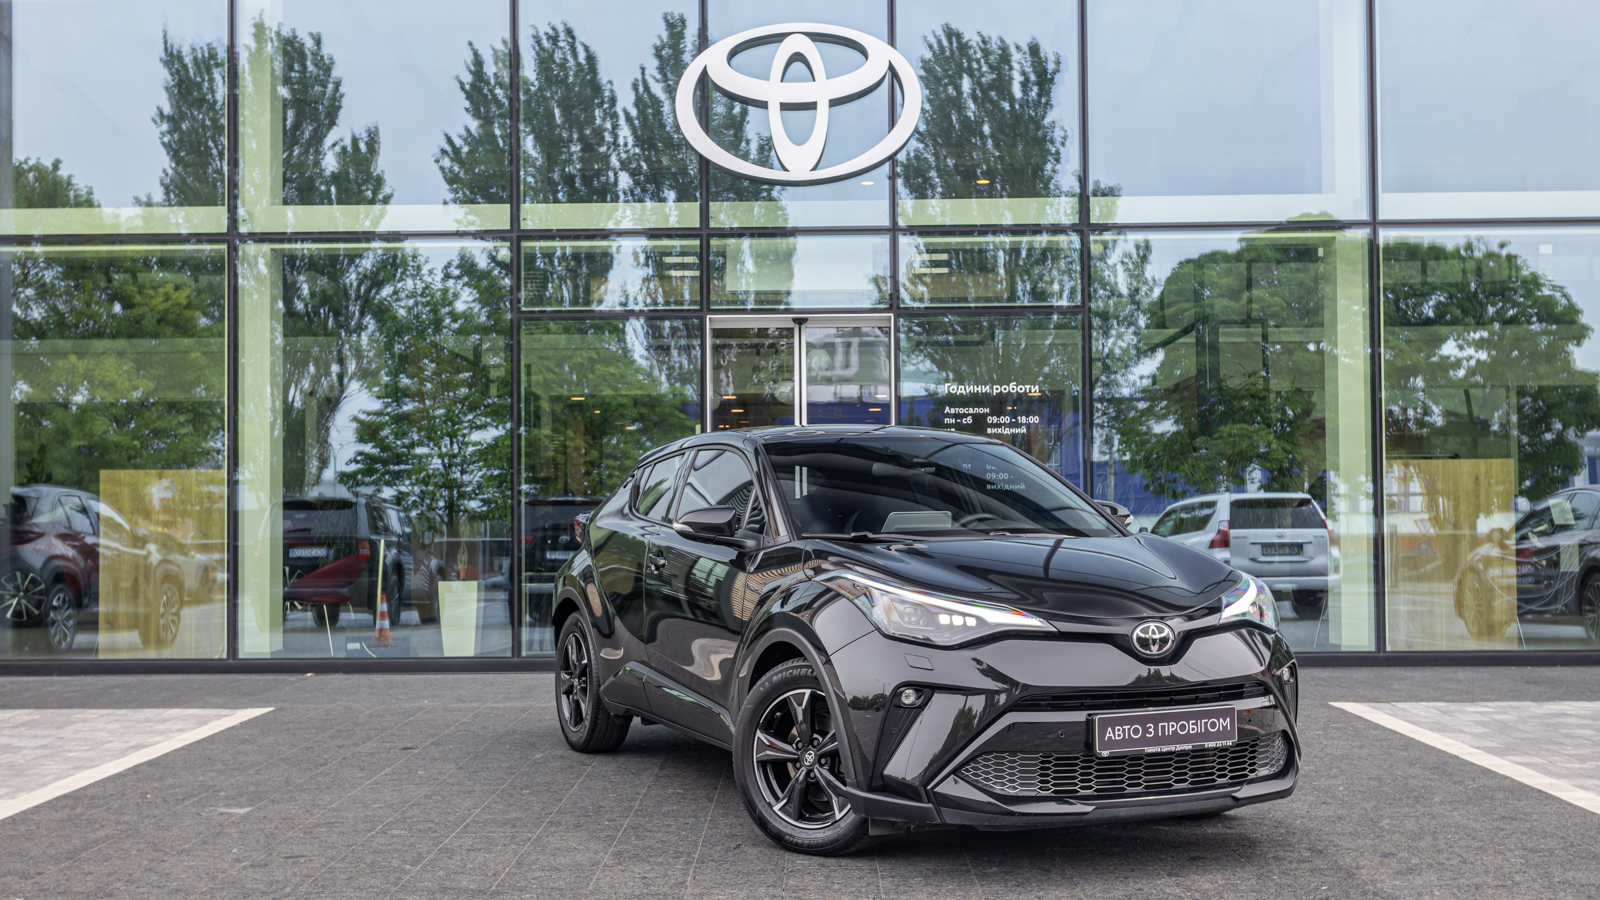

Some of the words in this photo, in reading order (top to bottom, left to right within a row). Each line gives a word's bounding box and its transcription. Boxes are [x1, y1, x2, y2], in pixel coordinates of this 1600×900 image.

[944, 382, 990, 396] Години
[993, 382, 1039, 396] роботи
[944, 406, 990, 414] Автосалон
[962, 415, 973, 424] сб
[987, 416, 1010, 424] 09:00
[1017, 416, 1040, 424] 18:00
[987, 426, 1027, 435] вихідний
[986, 472, 1009, 480] 09:00
[986, 482, 1026, 491] вихідний
[1105, 724, 1142, 741] АВТО
[1158, 717, 1231, 737] ПРОБІГОМ
